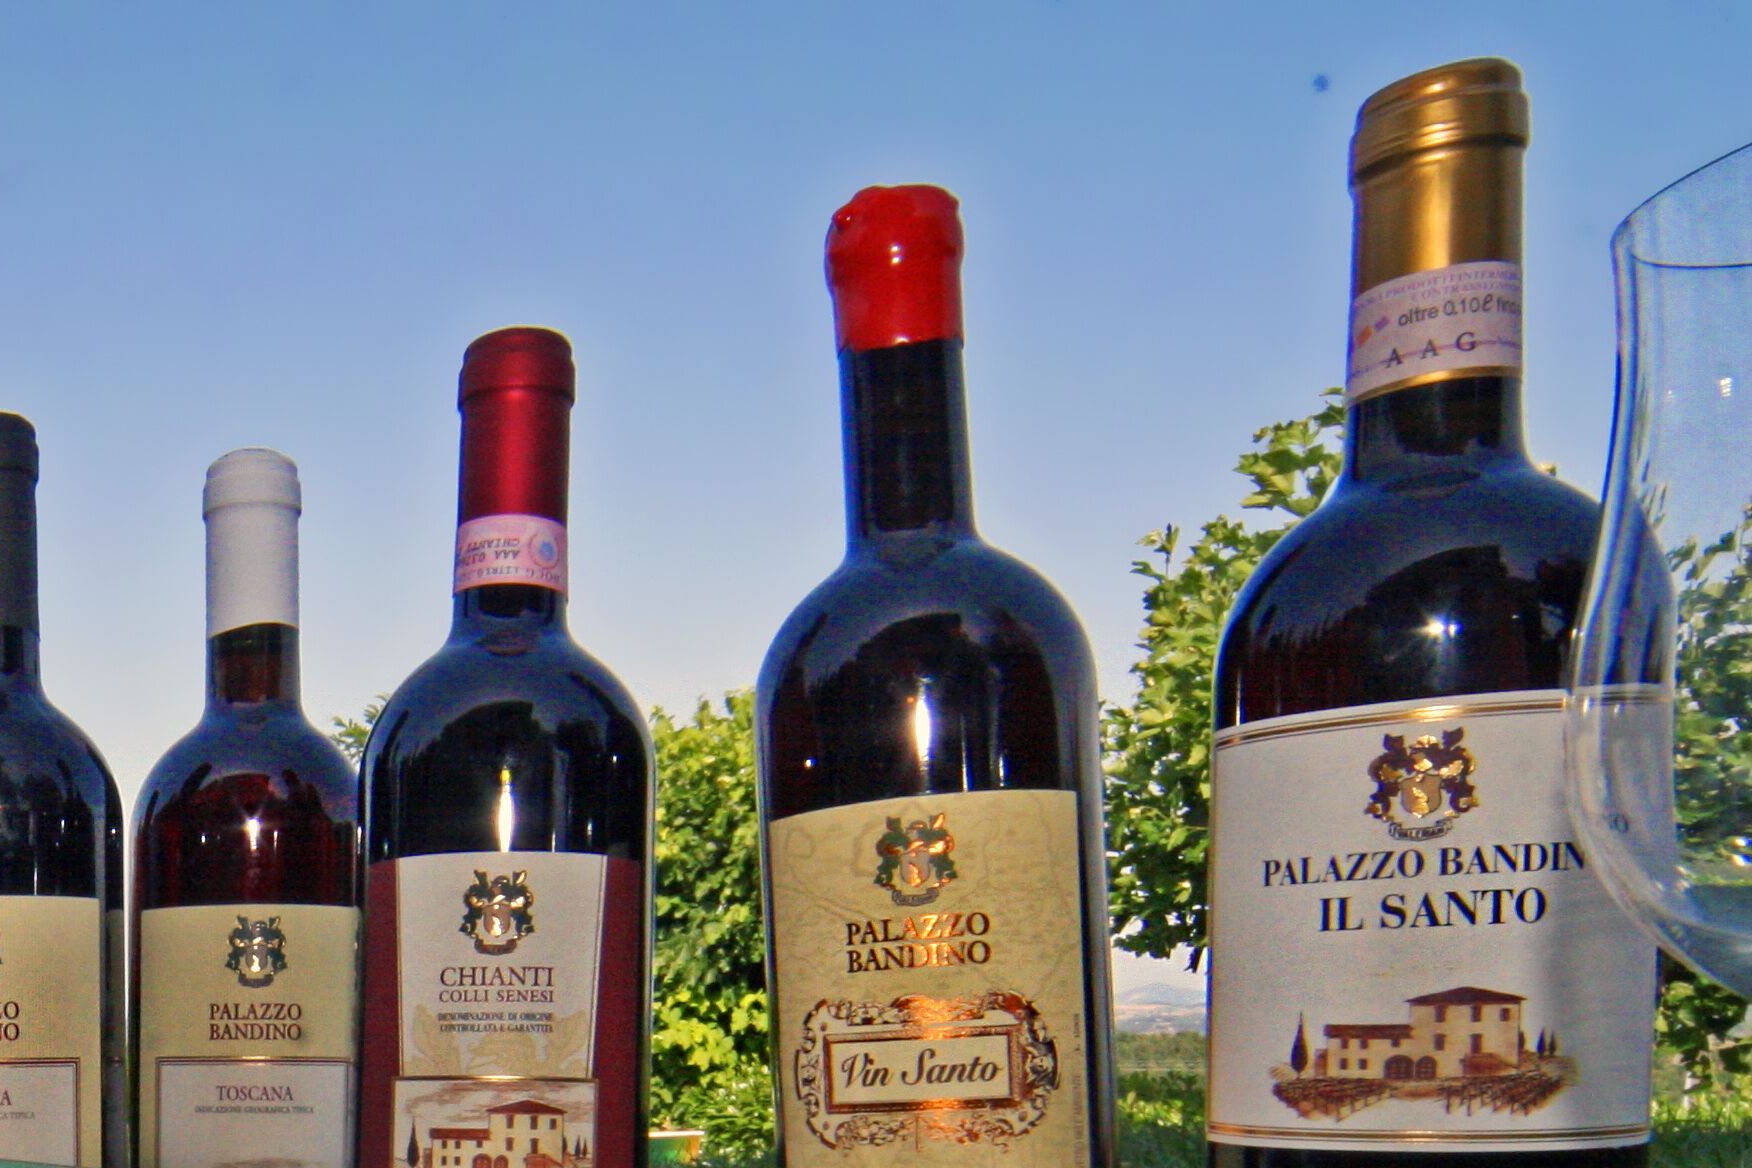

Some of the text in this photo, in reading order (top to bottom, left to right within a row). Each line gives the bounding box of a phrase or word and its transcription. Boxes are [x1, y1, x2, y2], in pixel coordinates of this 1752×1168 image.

[1398, 306, 1439, 327] oltre
[1263, 840, 1587, 887] PALAZZO BANDIN
[1318, 887, 1547, 932] IL SANTO
[846, 912, 990, 946] PALAZZO
[847, 940, 992, 973] BANDINO
[440, 966, 555, 988] CHIANTI
[439, 989, 555, 1003] COLLI SENESI
[209, 1003, 302, 1021] PALAZZO
[209, 1023, 302, 1041] BANDINO
[841, 1048, 1004, 1088] Vin Santo
[216, 1085, 294, 1101] TOSCANA
